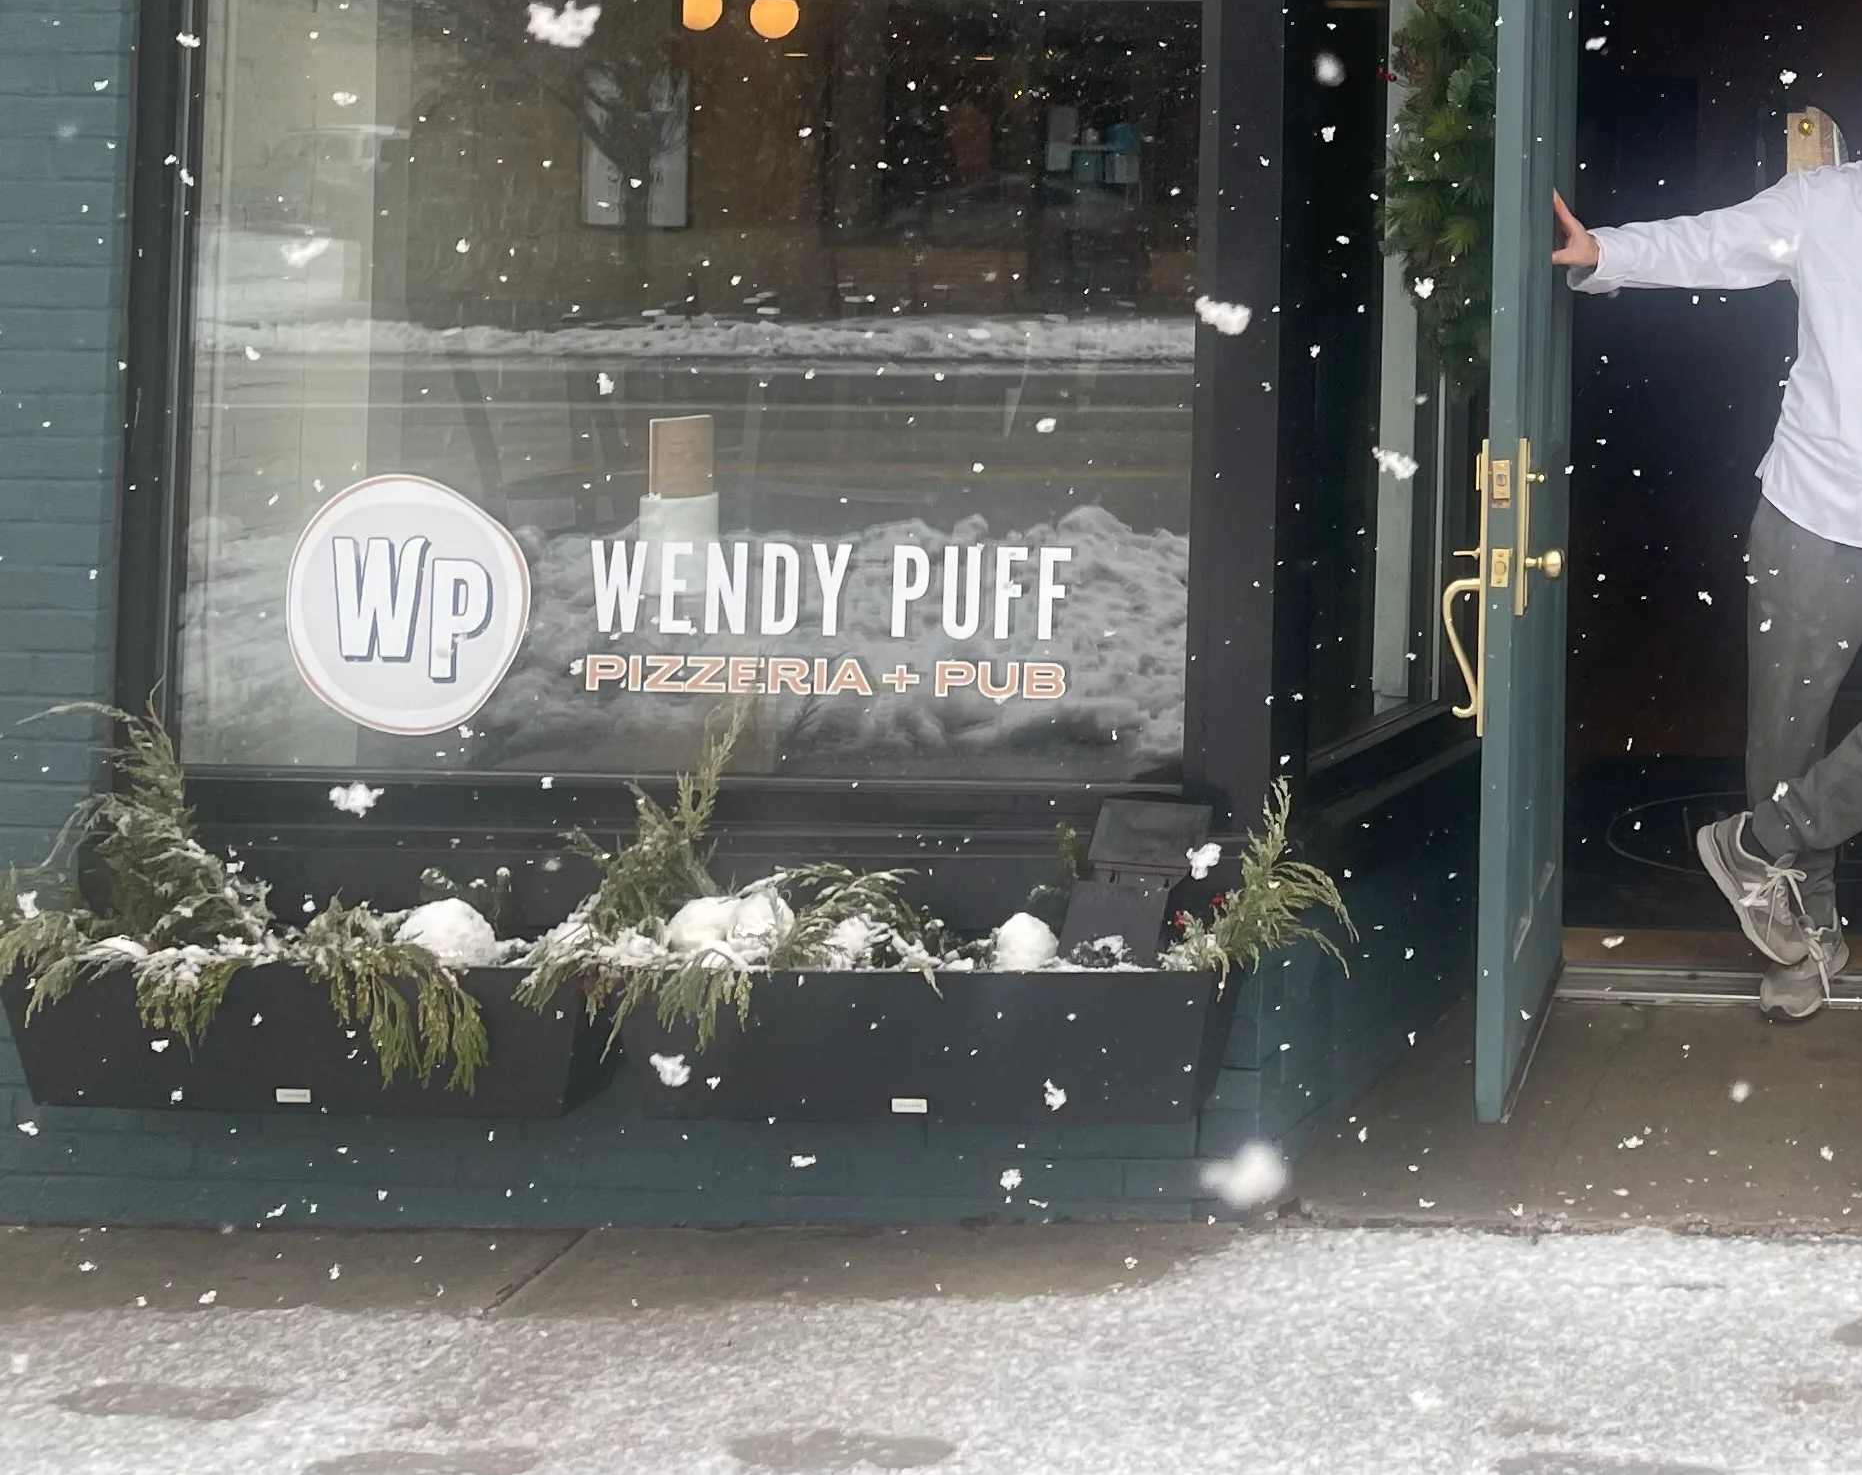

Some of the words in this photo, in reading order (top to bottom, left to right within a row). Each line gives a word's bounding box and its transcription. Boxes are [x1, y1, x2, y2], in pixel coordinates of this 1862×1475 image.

[332, 535, 494, 684] WP
[590, 539, 853, 637] WENDY
[890, 544, 1073, 641] PUFF
[585, 654, 873, 696] PIZZERIA
[882, 664, 920, 693] +
[934, 660, 1067, 700] PUB
